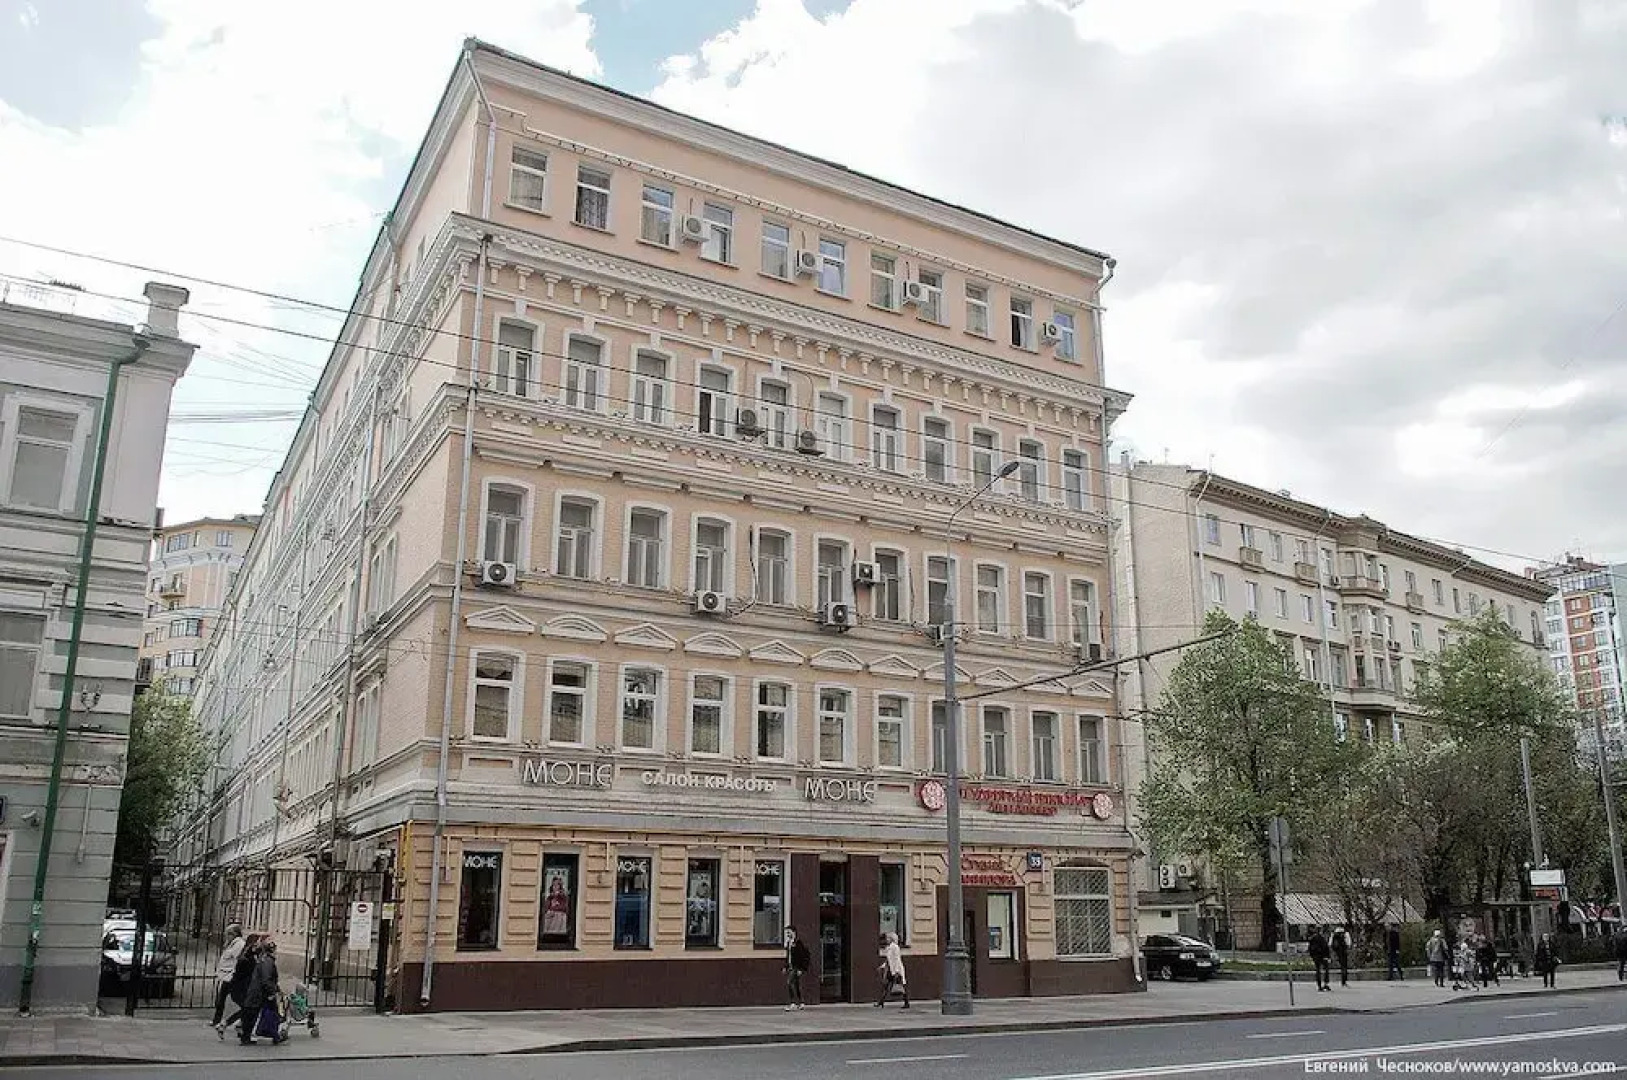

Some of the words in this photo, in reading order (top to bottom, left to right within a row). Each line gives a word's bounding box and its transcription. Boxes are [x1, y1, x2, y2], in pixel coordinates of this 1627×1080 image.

[523, 758, 613, 787] МОНЕ
[641, 770, 699, 787] САЛОН
[704, 775, 777, 793] КРАСОТЫ
[804, 777, 876, 801] МОНЕ
